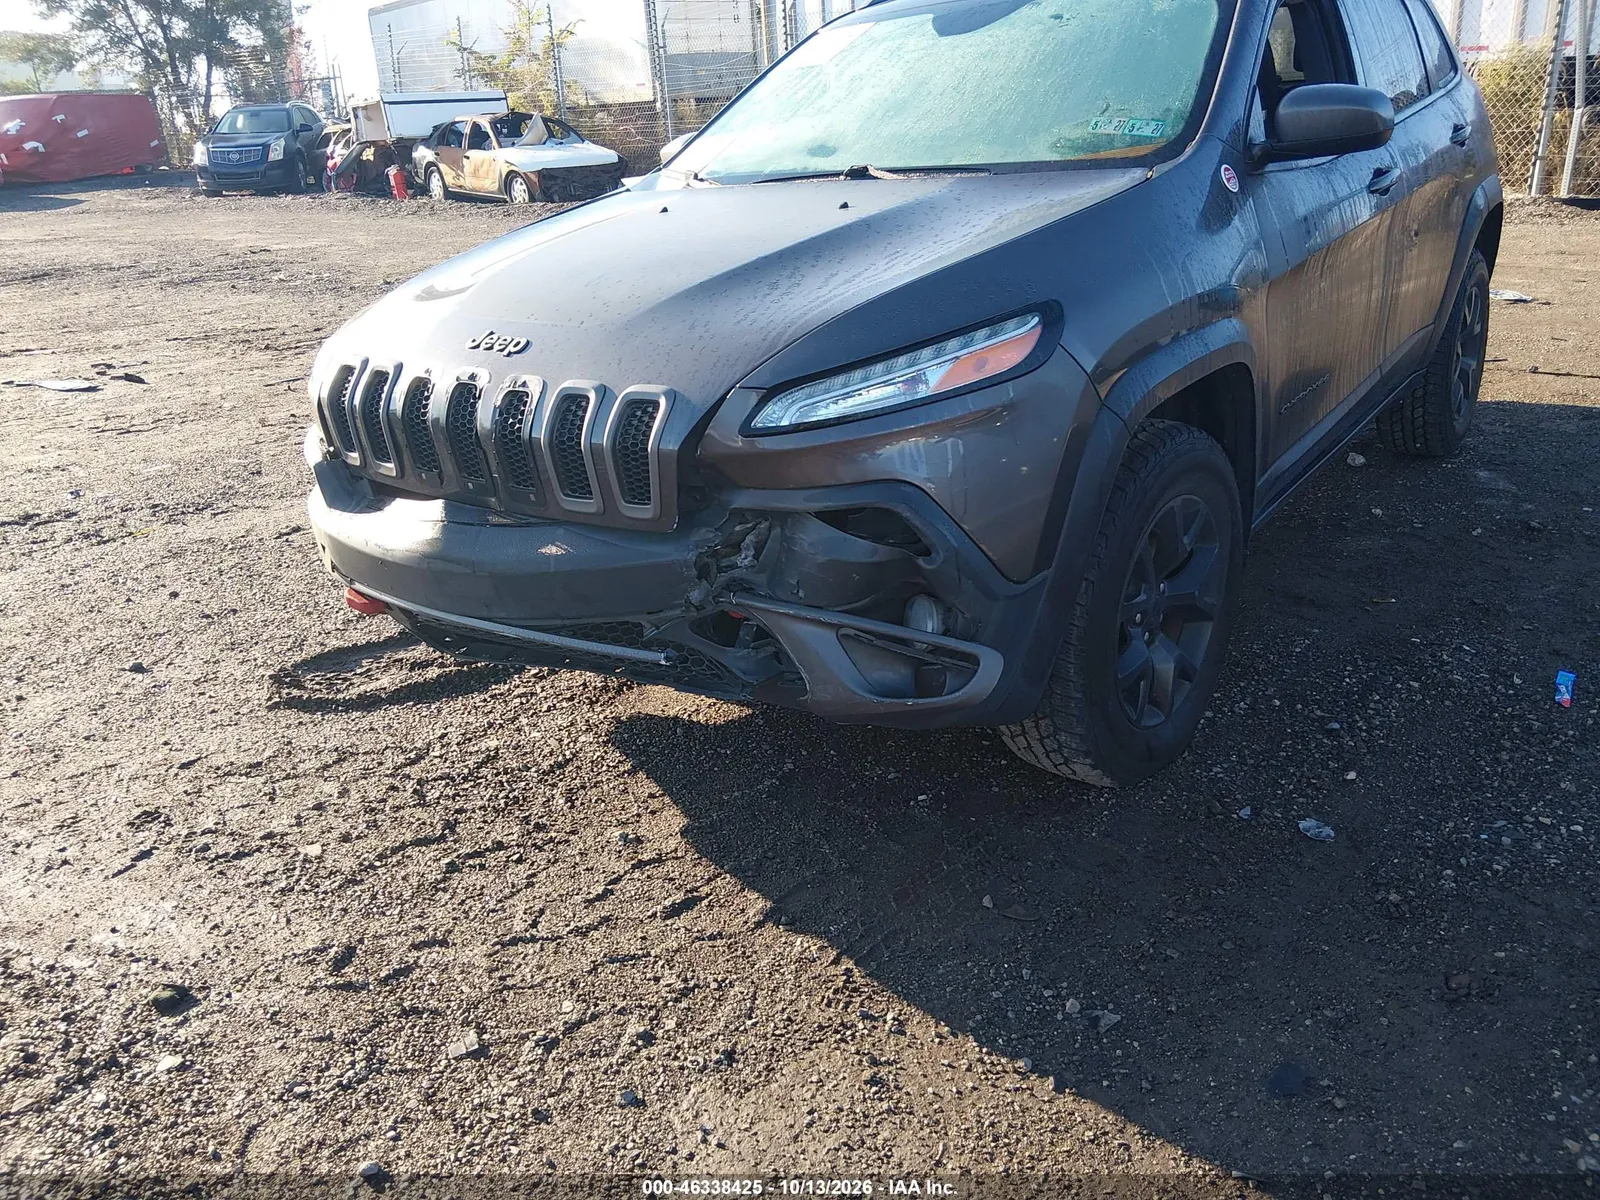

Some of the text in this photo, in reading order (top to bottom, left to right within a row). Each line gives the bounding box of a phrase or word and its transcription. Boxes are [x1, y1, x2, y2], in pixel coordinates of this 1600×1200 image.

[1091, 120, 1100, 131] 5
[1113, 119, 1126, 132] 27
[1128, 123, 1136, 133] 5
[1151, 123, 1164, 136] 27
[465, 330, 534, 358] Jeep
